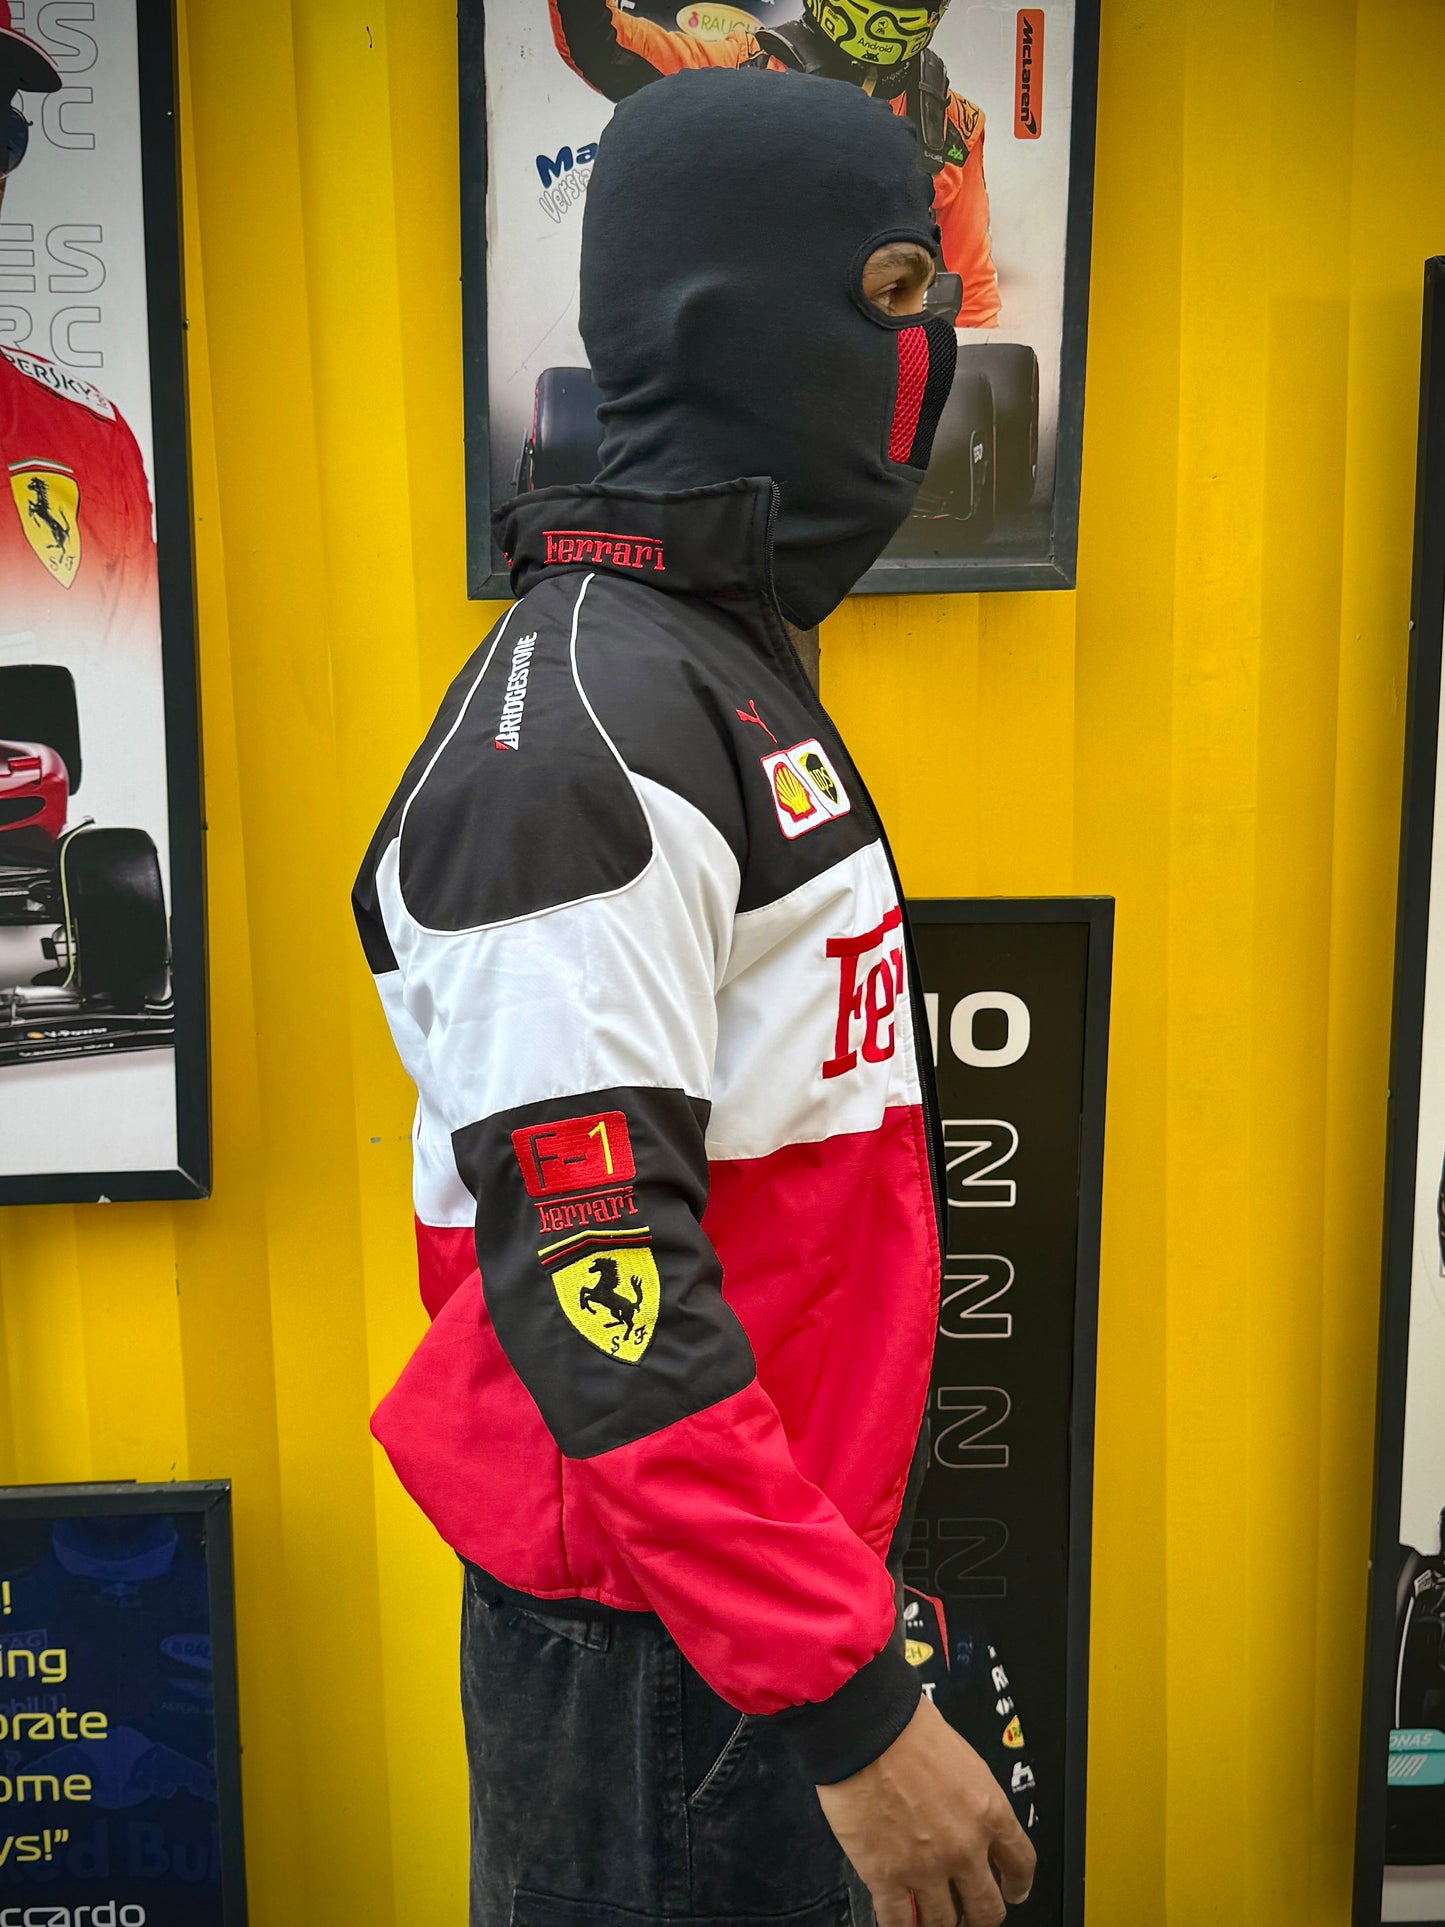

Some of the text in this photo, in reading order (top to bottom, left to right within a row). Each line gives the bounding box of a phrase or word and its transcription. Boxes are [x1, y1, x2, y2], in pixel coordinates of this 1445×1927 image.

[857, 37, 893, 54] Android
[536, 142, 599, 189] Ma
[541, 531, 666, 571] Ferrari
[495, 631, 538, 751] BRIDGESTONE
[534, 1186, 639, 1235] Ferrari
